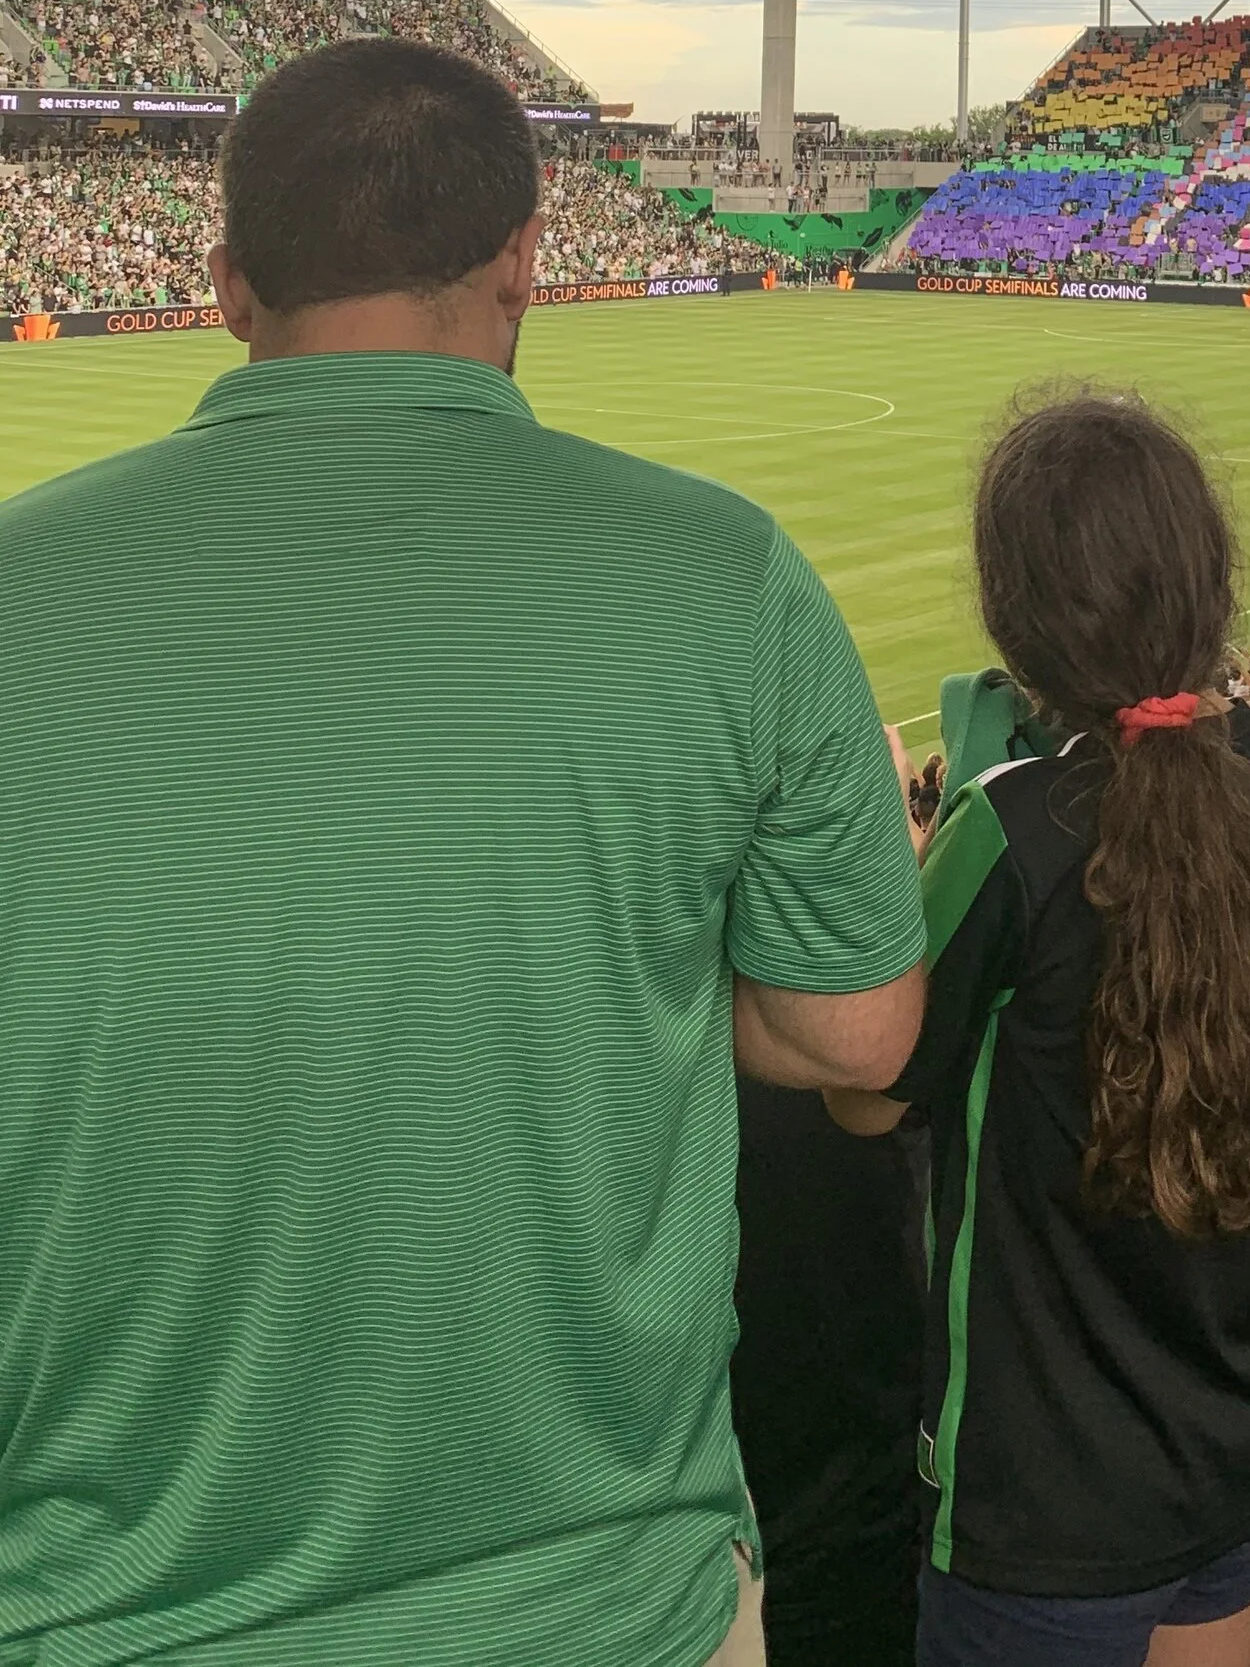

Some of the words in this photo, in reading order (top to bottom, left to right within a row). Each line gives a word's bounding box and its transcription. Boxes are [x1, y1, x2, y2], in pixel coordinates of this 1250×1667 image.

[55, 97, 120, 110] NETSPEND
[530, 288, 549, 305] LD
[552, 287, 577, 303] CUP
[580, 282, 646, 300] SEMIFINALS
[647, 281, 669, 296] ARE
[672, 278, 718, 295] COMING
[917, 276, 953, 293] GOLD
[956, 277, 982, 294] CUP
[985, 279, 1059, 297] SEMIFINALS
[1060, 283, 1086, 298] ARE
[1089, 283, 1148, 301] COMING
[107, 313, 157, 332] GOLD
[161, 310, 196, 329] CUP
